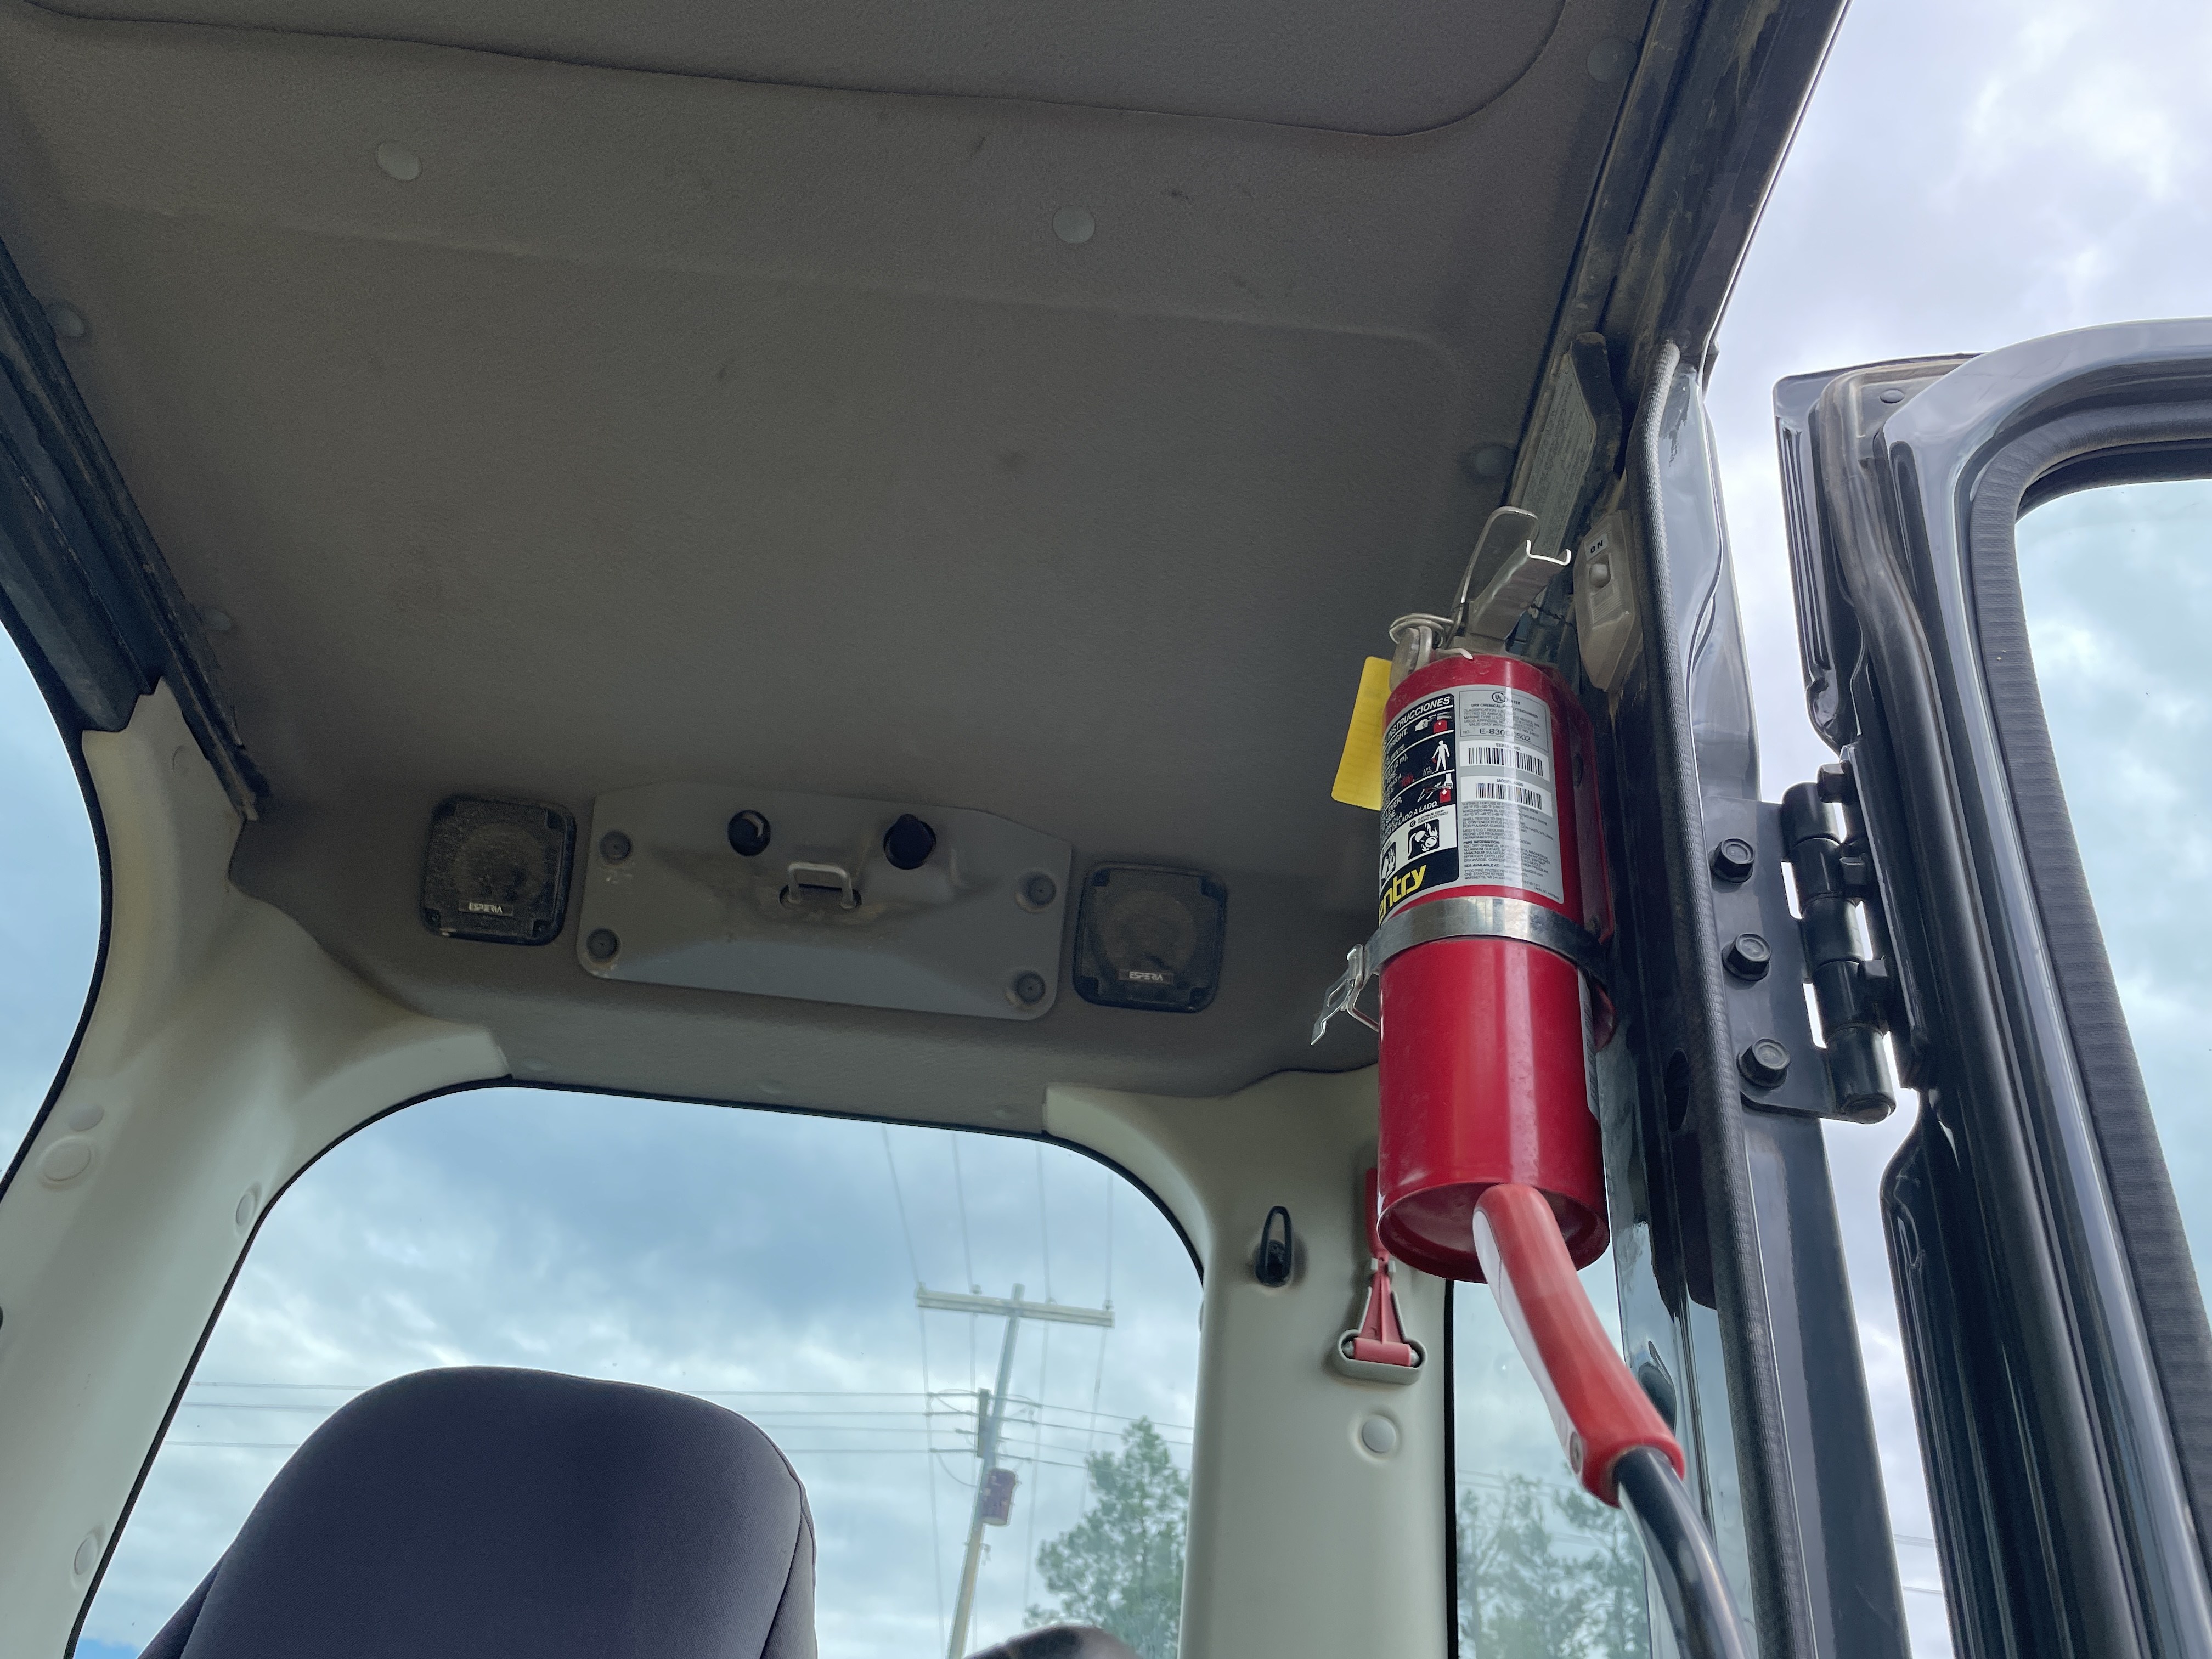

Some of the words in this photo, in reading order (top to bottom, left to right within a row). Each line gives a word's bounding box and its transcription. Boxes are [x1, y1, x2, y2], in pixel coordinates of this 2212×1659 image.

[1590, 540, 1603, 554] ON
[1386, 696, 1451, 741] INSTRUCCIONES
[1129, 971, 1164, 981] ESPERIA
